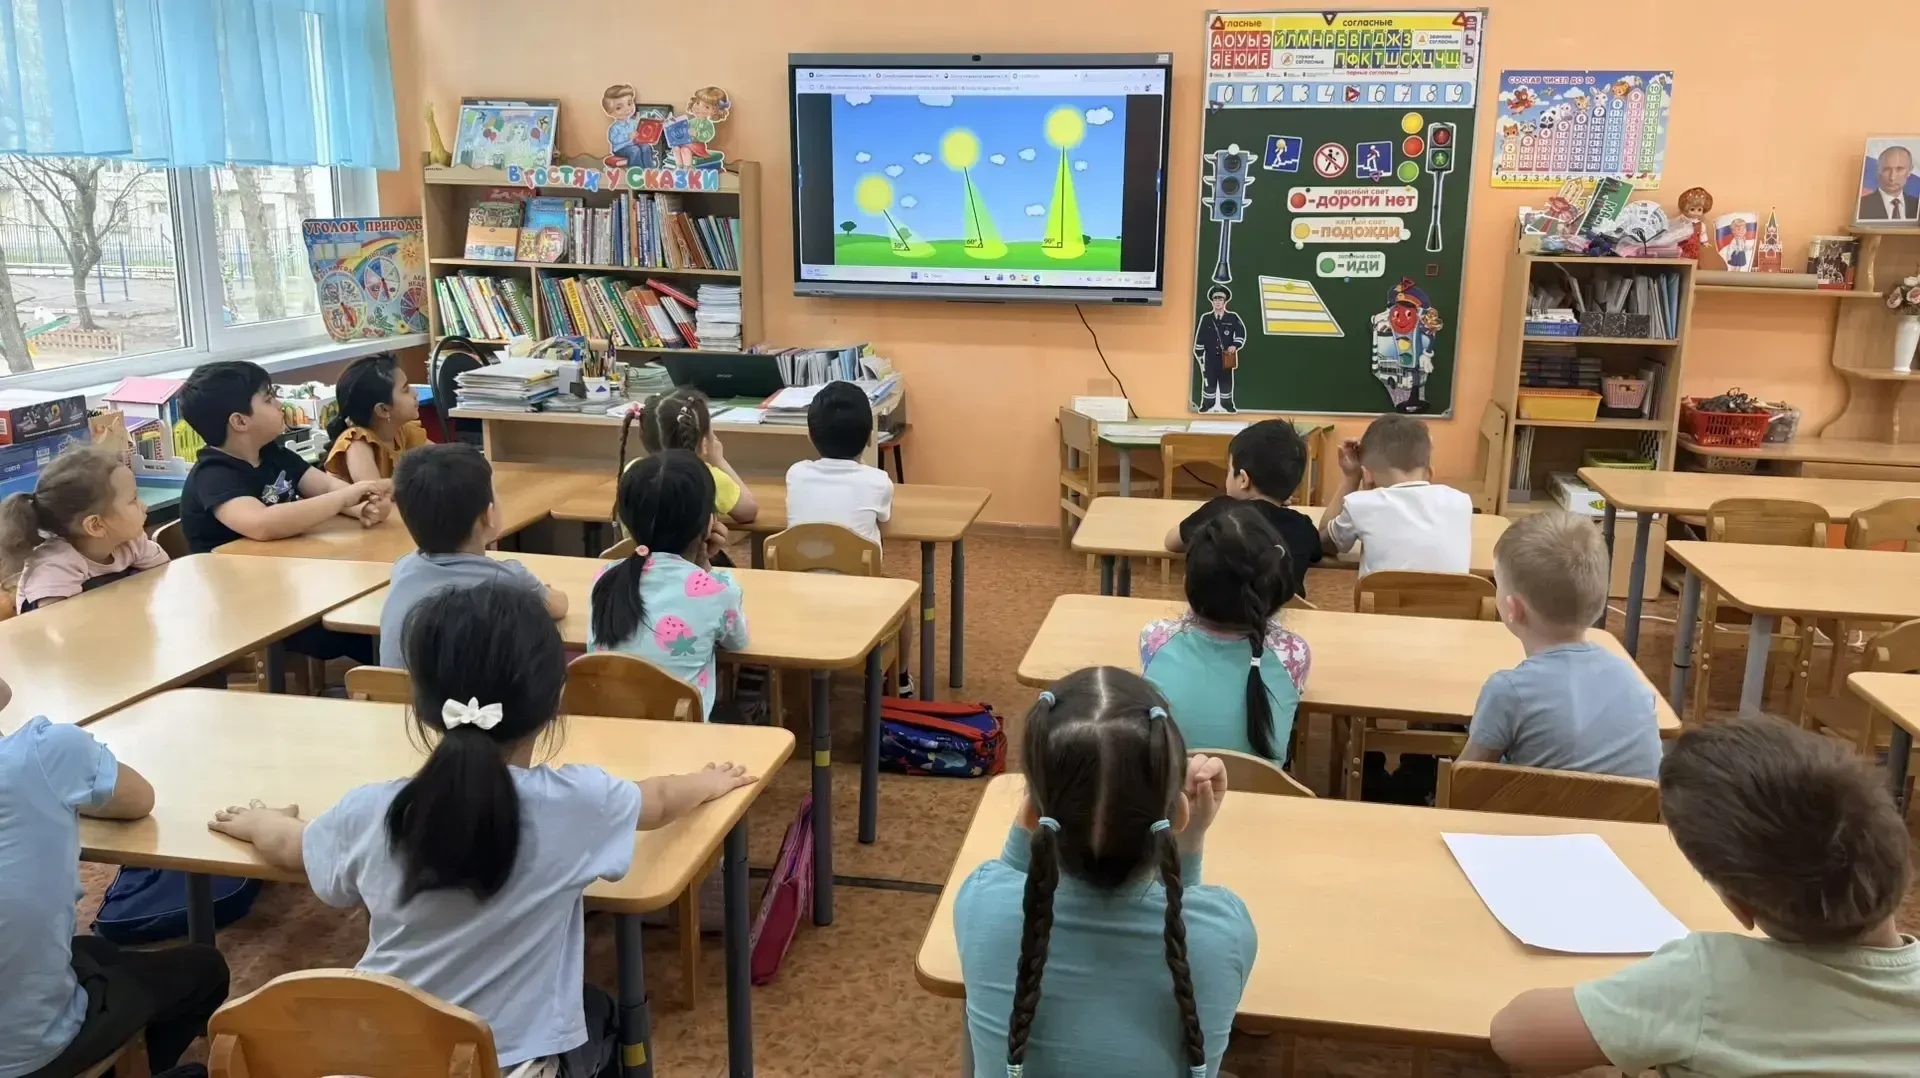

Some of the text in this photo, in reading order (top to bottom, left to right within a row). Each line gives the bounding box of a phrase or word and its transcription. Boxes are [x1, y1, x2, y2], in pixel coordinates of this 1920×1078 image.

[1508, 76, 1596, 85] СОСТАВ ЧИСЕЛ ДО 10
[1224, 84, 1234, 102] 0
[1251, 84, 1260, 102] 1
[1272, 84, 1284, 102] 2
[1299, 84, 1310, 102] 3
[1324, 84, 1335, 102] 4
[1374, 84, 1385, 102] 6
[1401, 84, 1412, 102] 7
[1426, 84, 1438, 102] 8
[1452, 84, 1463, 102] 9
[508, 164, 720, 192] В ГОСТЯХ У СКАЗКИ
[1385, 195, 1415, 206] нет
[304, 221, 359, 234] УГОЛОК
